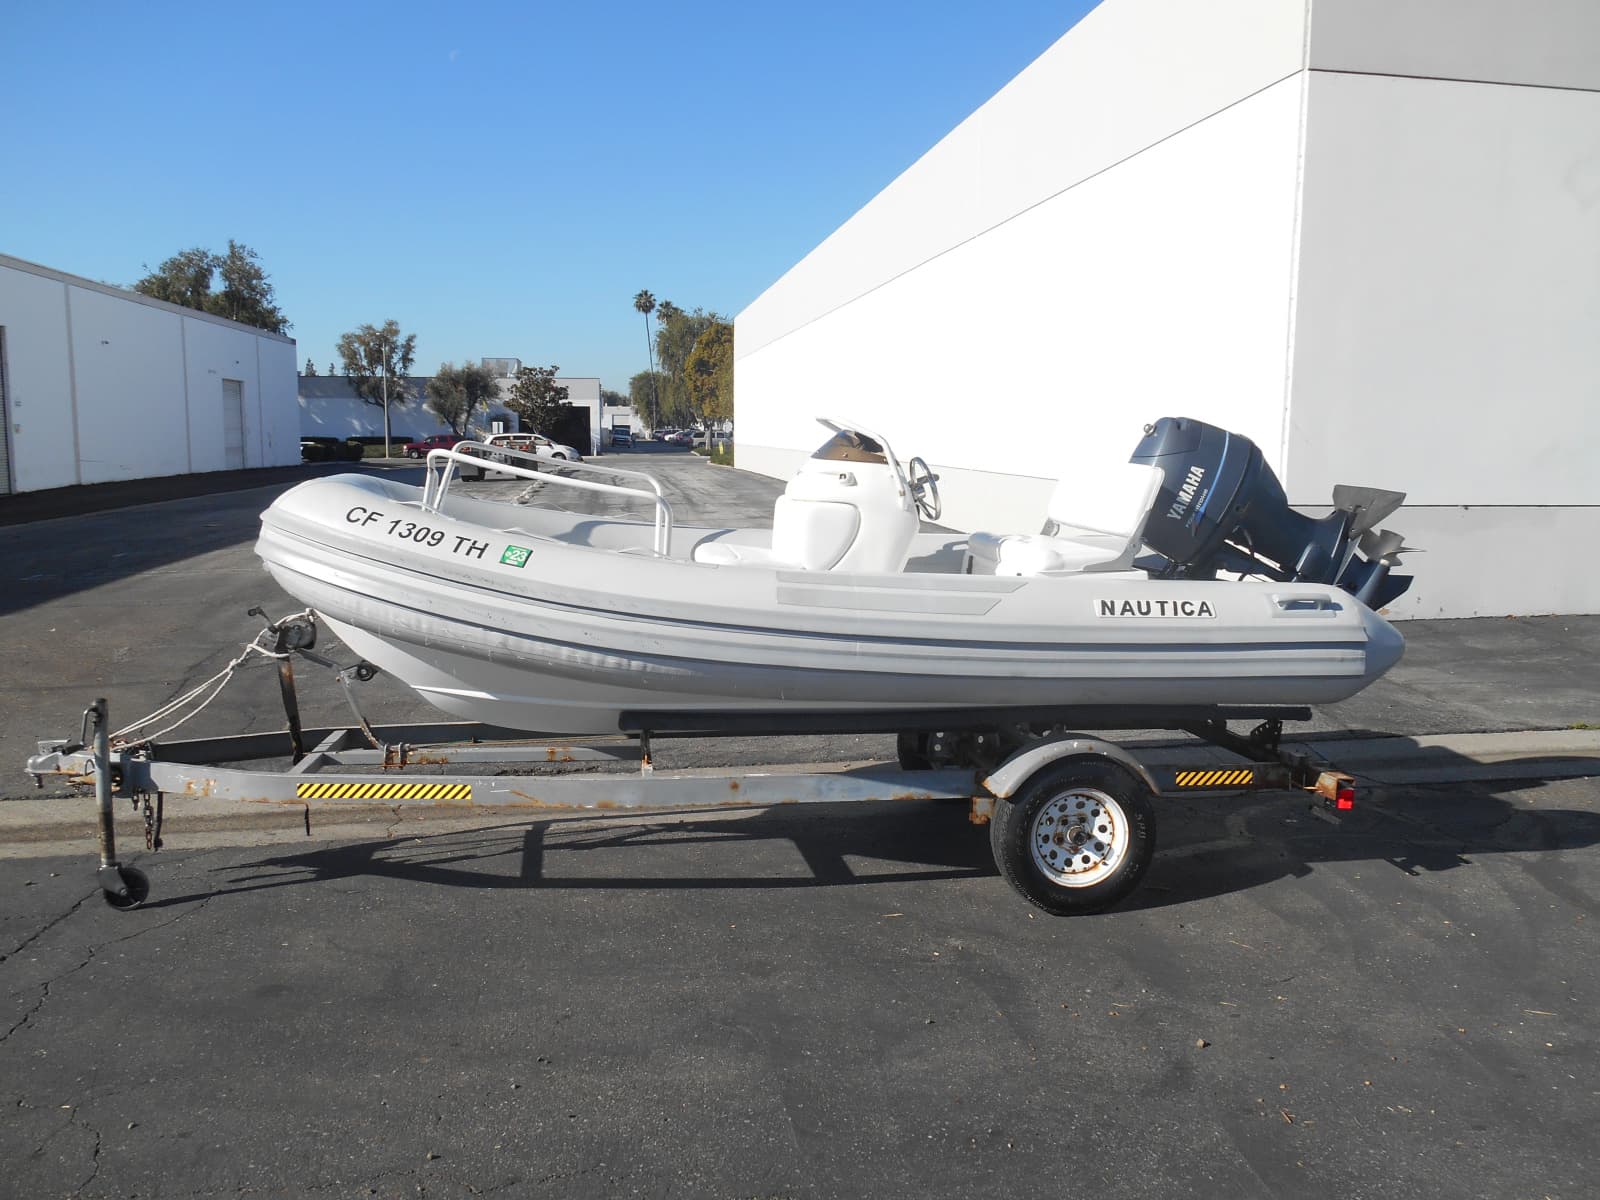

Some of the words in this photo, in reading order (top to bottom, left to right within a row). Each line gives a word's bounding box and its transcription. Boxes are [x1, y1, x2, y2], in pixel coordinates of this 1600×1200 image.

[1167, 466, 1205, 519] YAMAHA
[345, 506, 384, 526] CF
[387, 519, 445, 547] 1309
[452, 535, 490, 559] TH
[511, 548, 527, 562] 23
[1101, 600, 1213, 616] NAUTICA
